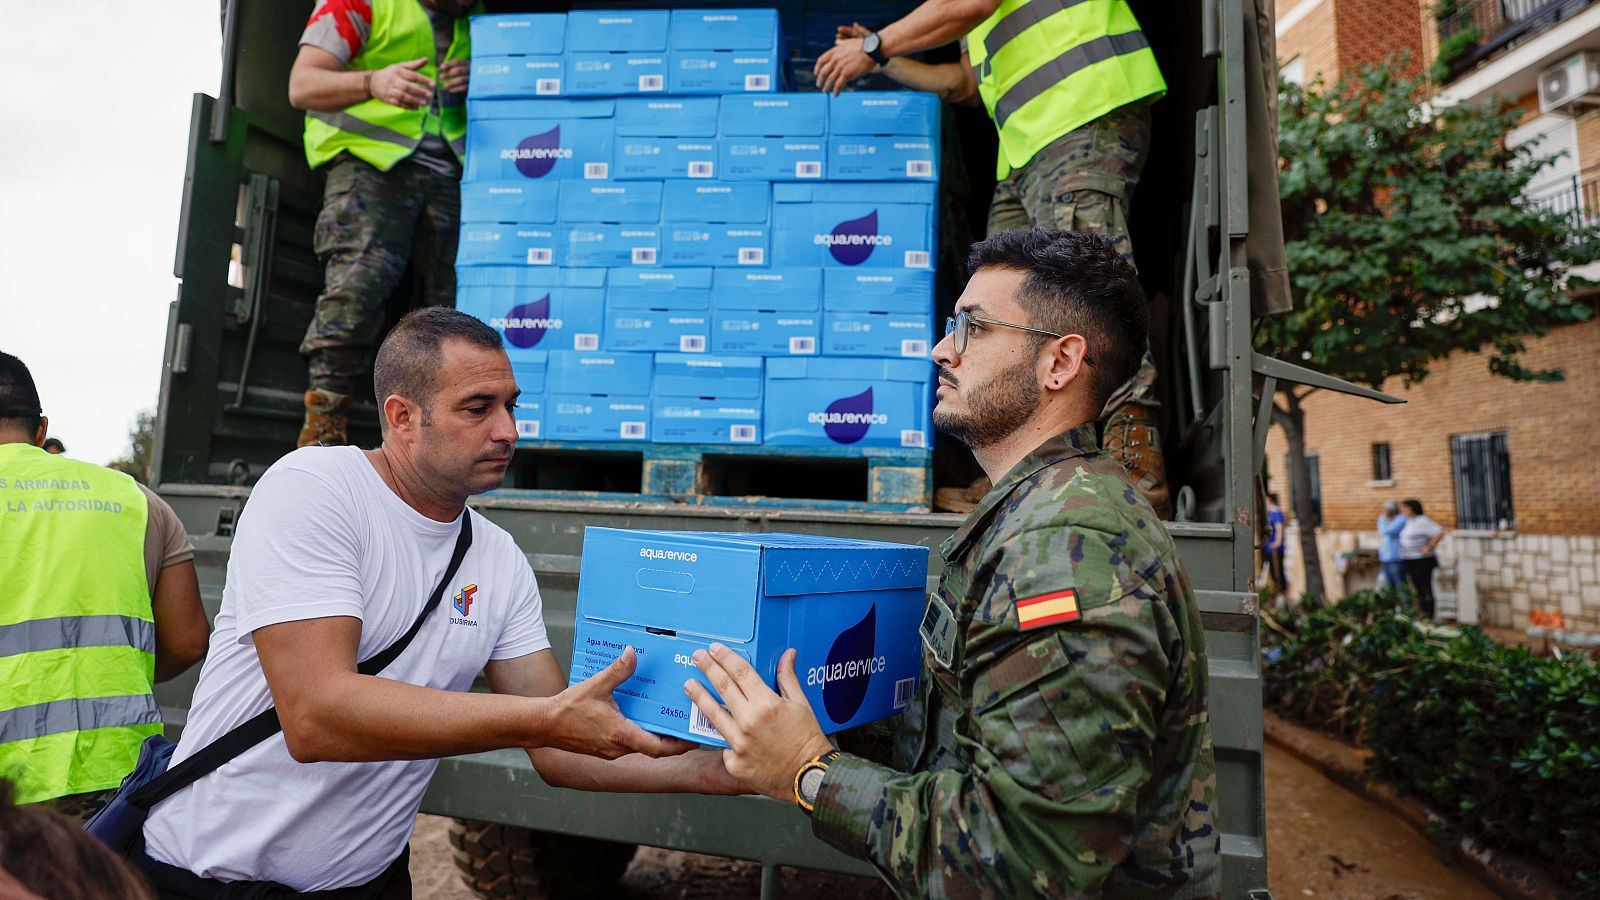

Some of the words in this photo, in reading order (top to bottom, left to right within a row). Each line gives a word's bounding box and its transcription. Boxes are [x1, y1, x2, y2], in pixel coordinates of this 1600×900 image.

[501, 148, 573, 162] aquaservice
[814, 234, 892, 248] aquaservice
[490, 318, 563, 331] aquaservice
[808, 412, 888, 426] aquaservice
[13, 479, 90, 490] ARMADAS
[7, 500, 28, 512] LA
[33, 499, 122, 513] AUTORIDAD
[640, 547, 698, 562] aquaservice
[586, 637, 601, 646] Agua
[602, 639, 623, 650] Mineral
[807, 655, 886, 690] aquaservice
